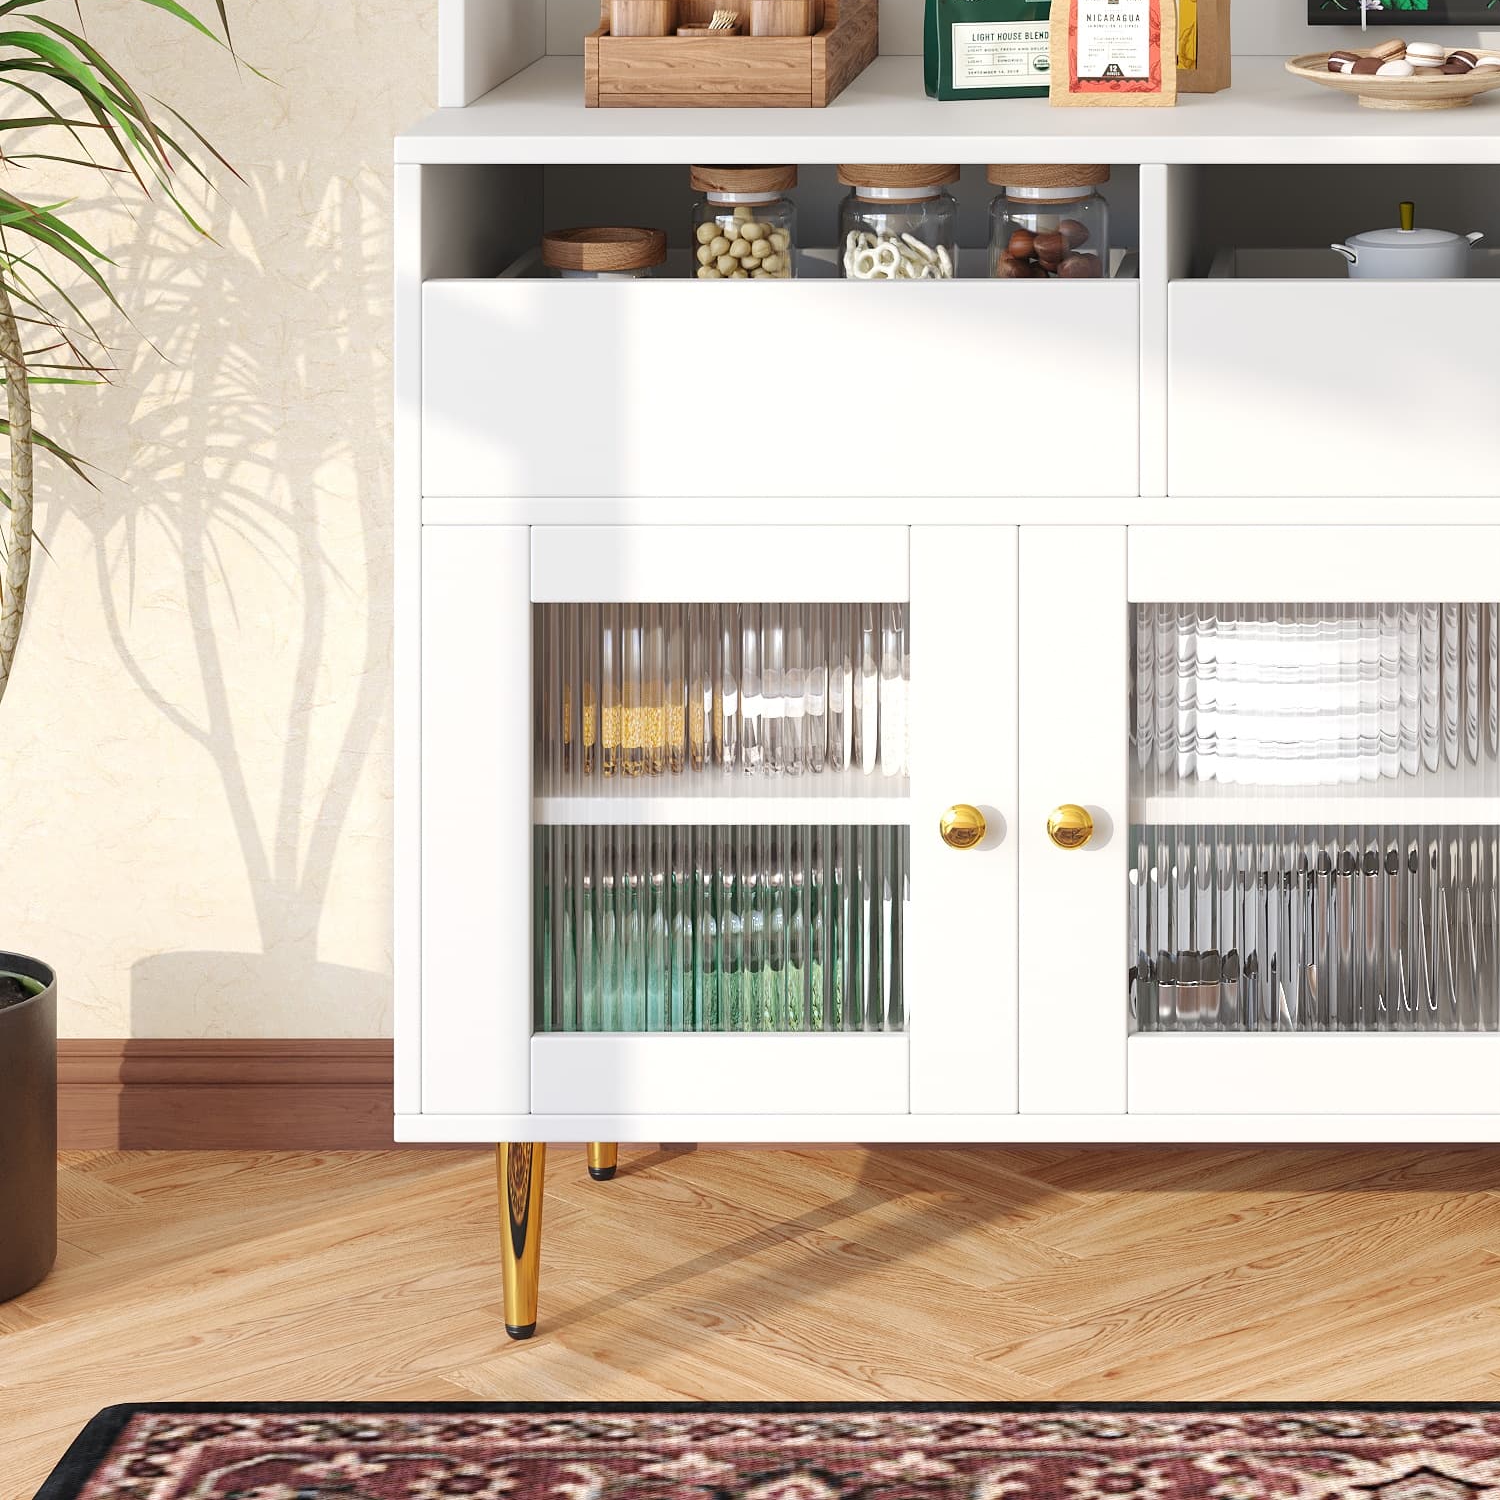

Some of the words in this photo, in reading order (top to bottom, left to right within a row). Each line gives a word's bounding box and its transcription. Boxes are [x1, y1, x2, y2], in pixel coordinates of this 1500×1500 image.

[1086, 14, 1140, 22] NICARAGUA
[972, 33, 995, 42] LIGHT
[997, 32, 1022, 41] HOUSE
[1024, 31, 1049, 40] BLEND
